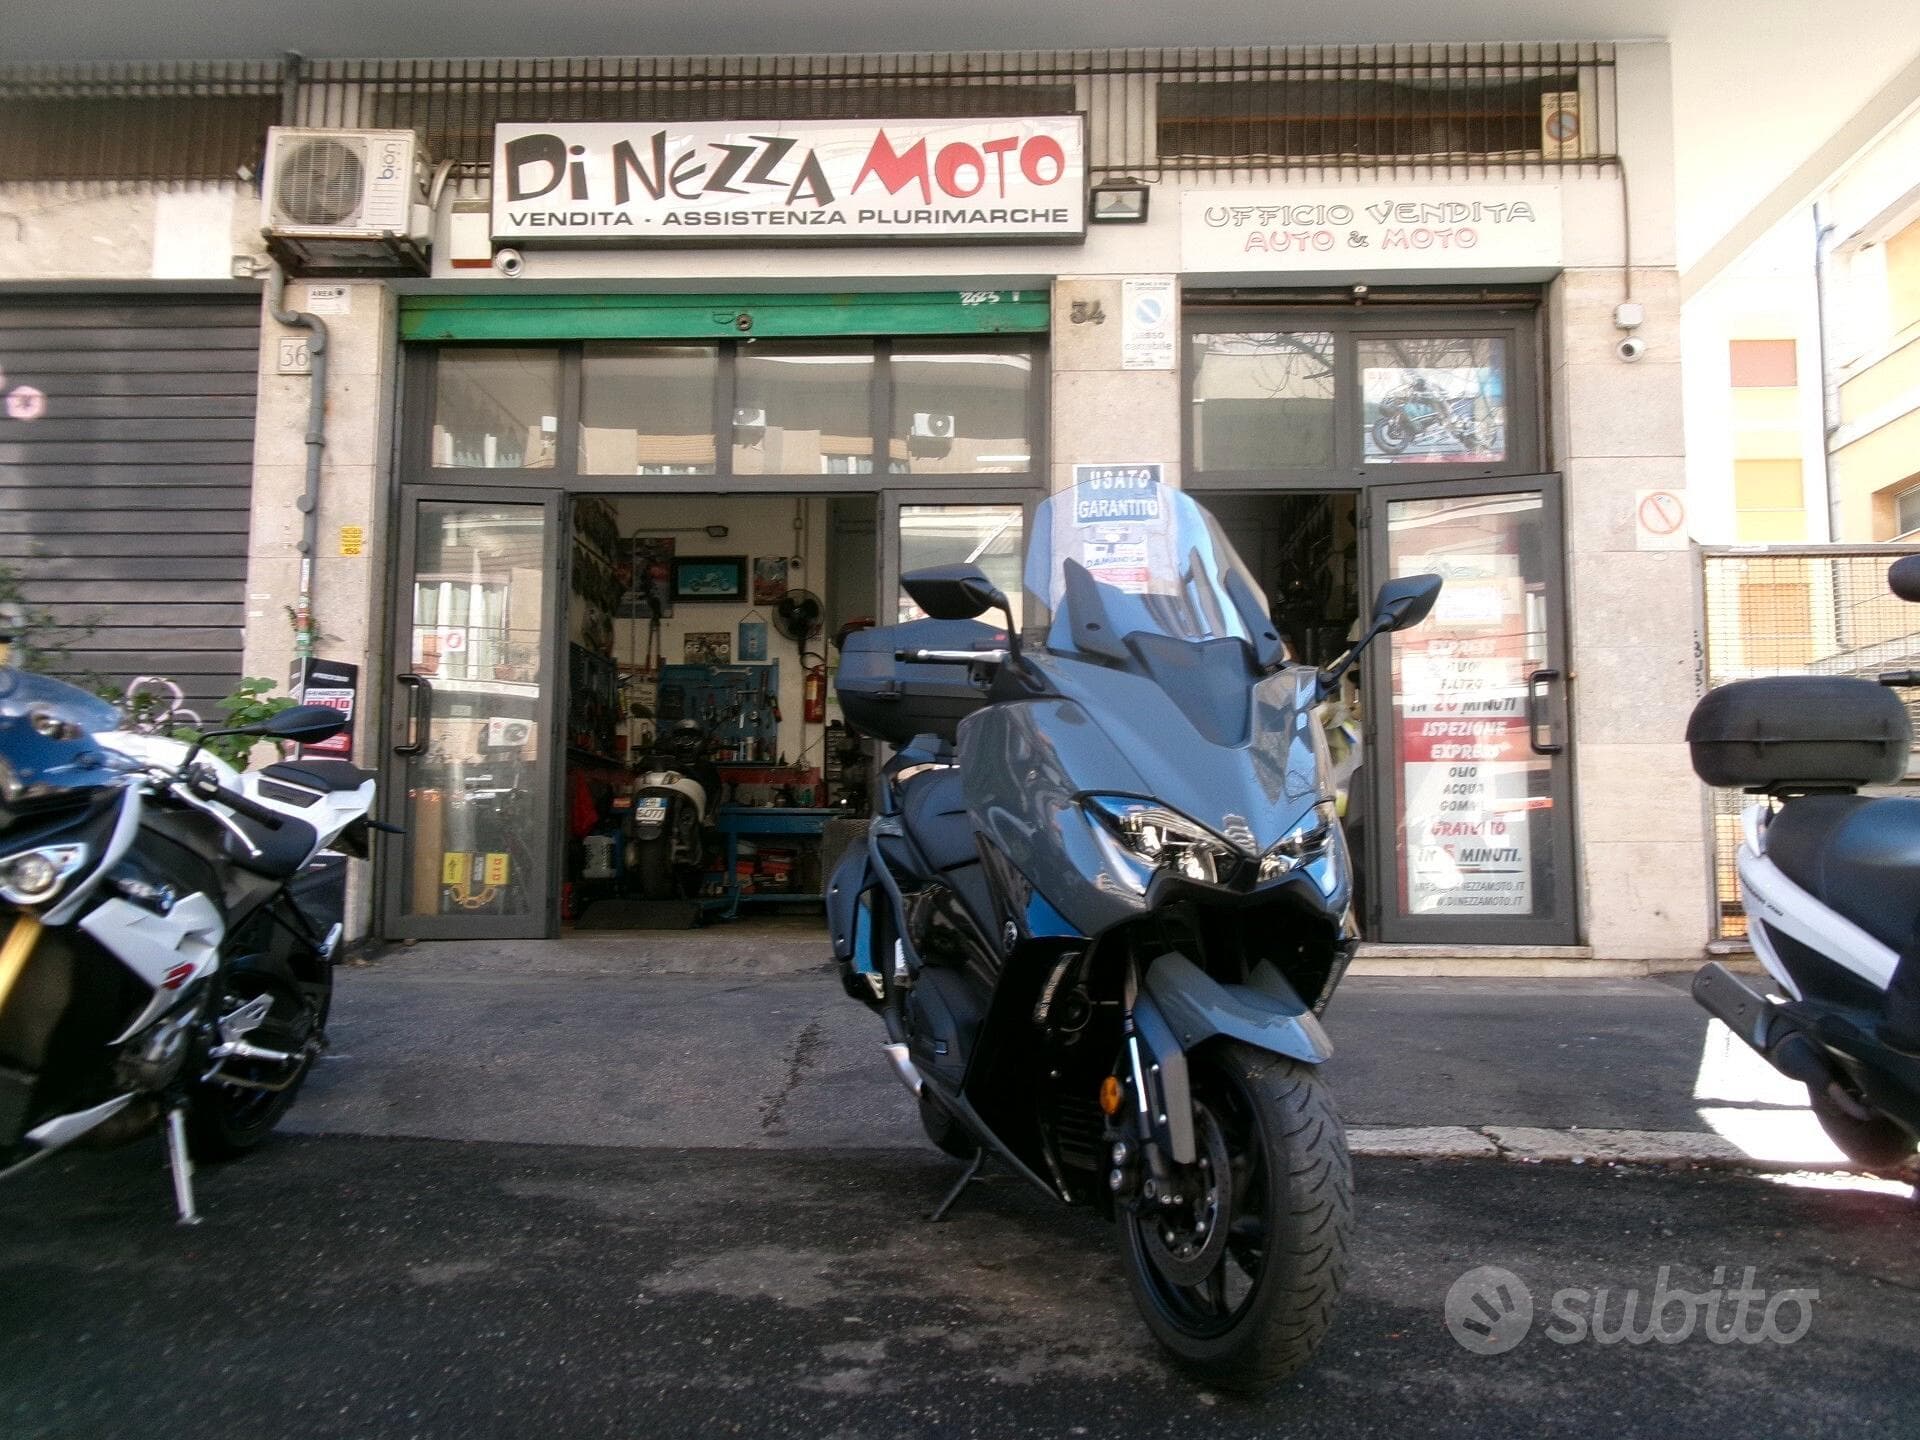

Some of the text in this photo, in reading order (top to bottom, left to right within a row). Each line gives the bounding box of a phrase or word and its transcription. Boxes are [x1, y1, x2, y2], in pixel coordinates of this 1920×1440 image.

[850, 128, 1066, 206] MOTO
[509, 211, 633, 228] VENDITA
[662, 209, 847, 227] ASSISTENZA
[858, 207, 1069, 226] PLURIMARCHE
[1204, 200, 1536, 228] UFFICIO VENDITA
[1244, 227, 1478, 253] AUTO & MOTO
[1070, 300, 1106, 325] 34
[280, 345, 309, 367] 36
[1090, 469, 1151, 490] USATO
[1079, 499, 1158, 519] GARANTITO
[1422, 721, 1508, 737] ISPEZIONE
[1449, 767, 1478, 777] OLIO
